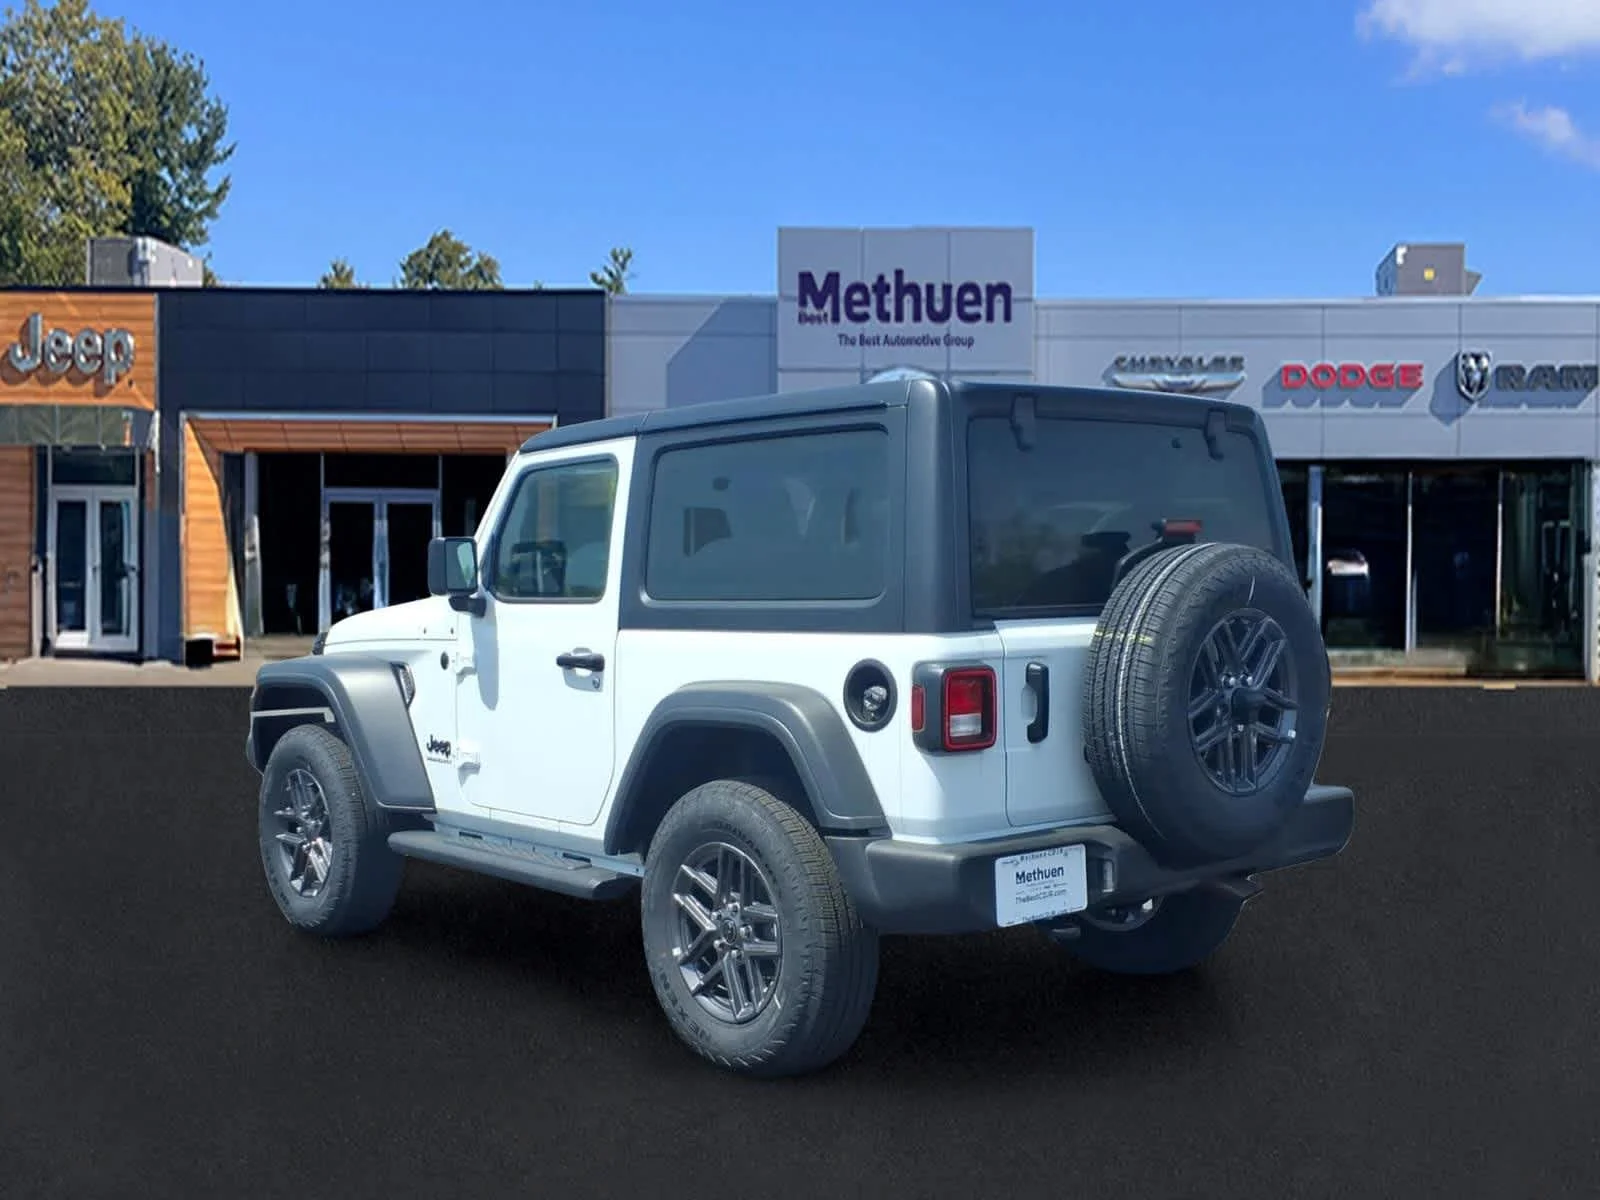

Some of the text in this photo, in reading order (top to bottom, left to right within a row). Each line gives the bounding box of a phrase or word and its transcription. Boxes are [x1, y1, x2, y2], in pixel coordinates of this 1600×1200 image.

[798, 269, 1012, 323] Methuen
[798, 311, 829, 325] Best
[9, 312, 135, 385] Jeep
[838, 333, 975, 349] The Best Automotive Group
[1281, 363, 1424, 389] DODGE
[1495, 365, 1598, 391] RAM
[426, 734, 451, 758] Jeep
[1015, 866, 1064, 884] Methuen
